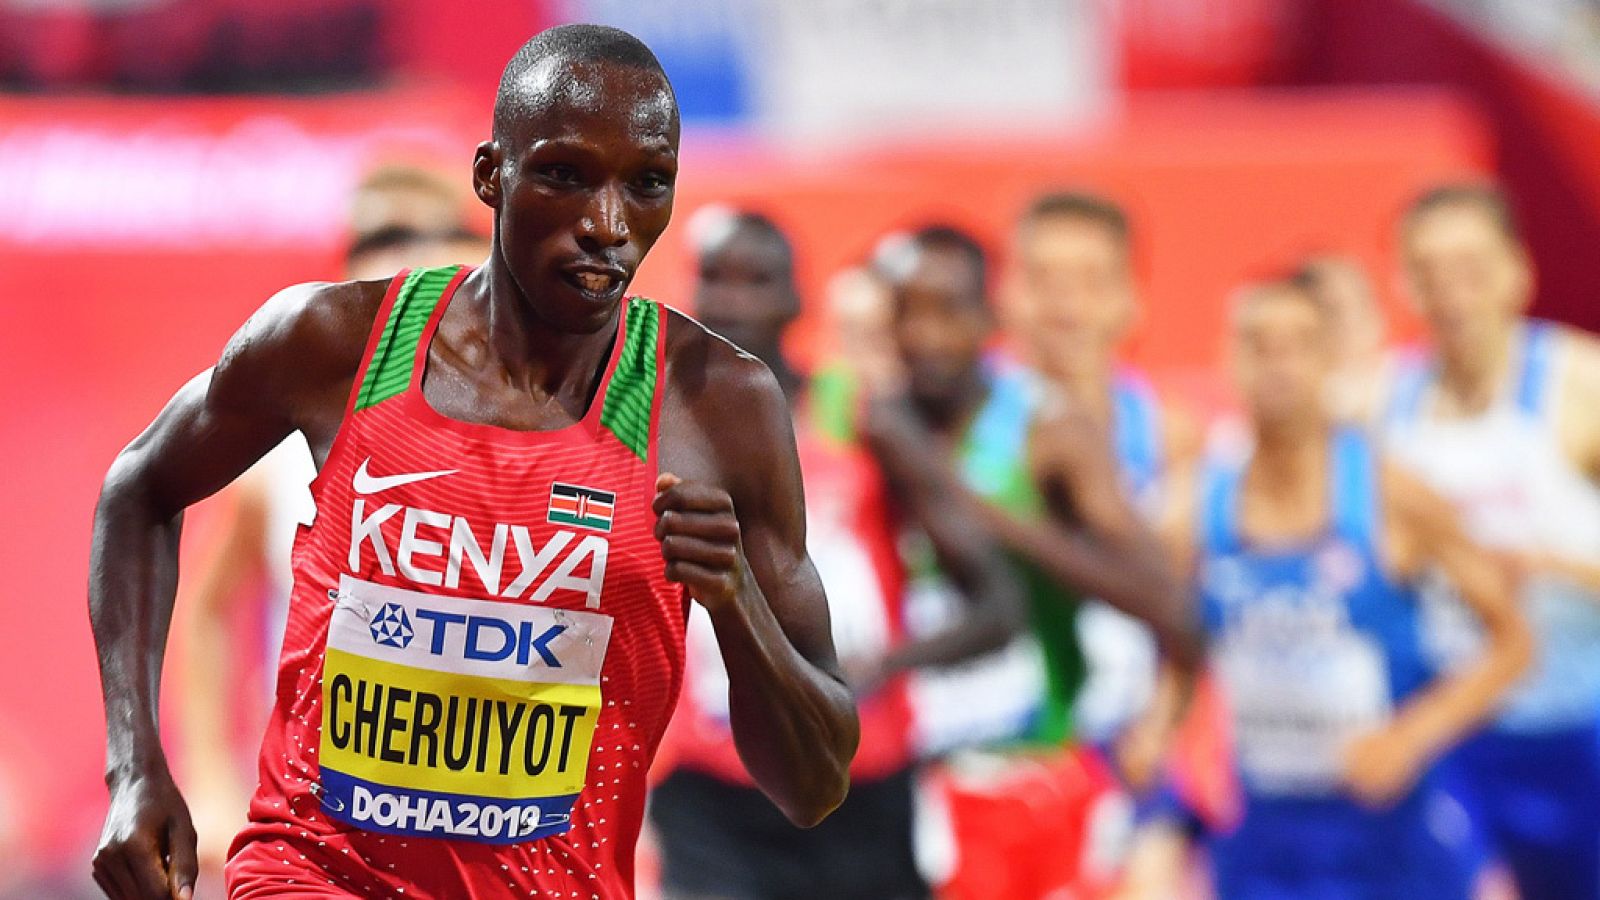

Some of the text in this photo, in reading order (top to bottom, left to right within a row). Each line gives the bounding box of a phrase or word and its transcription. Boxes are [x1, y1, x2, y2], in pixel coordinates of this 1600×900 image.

[348, 499, 609, 608] KENYA
[416, 609, 569, 667] TDK
[330, 674, 587, 776] CHERUIYOT
